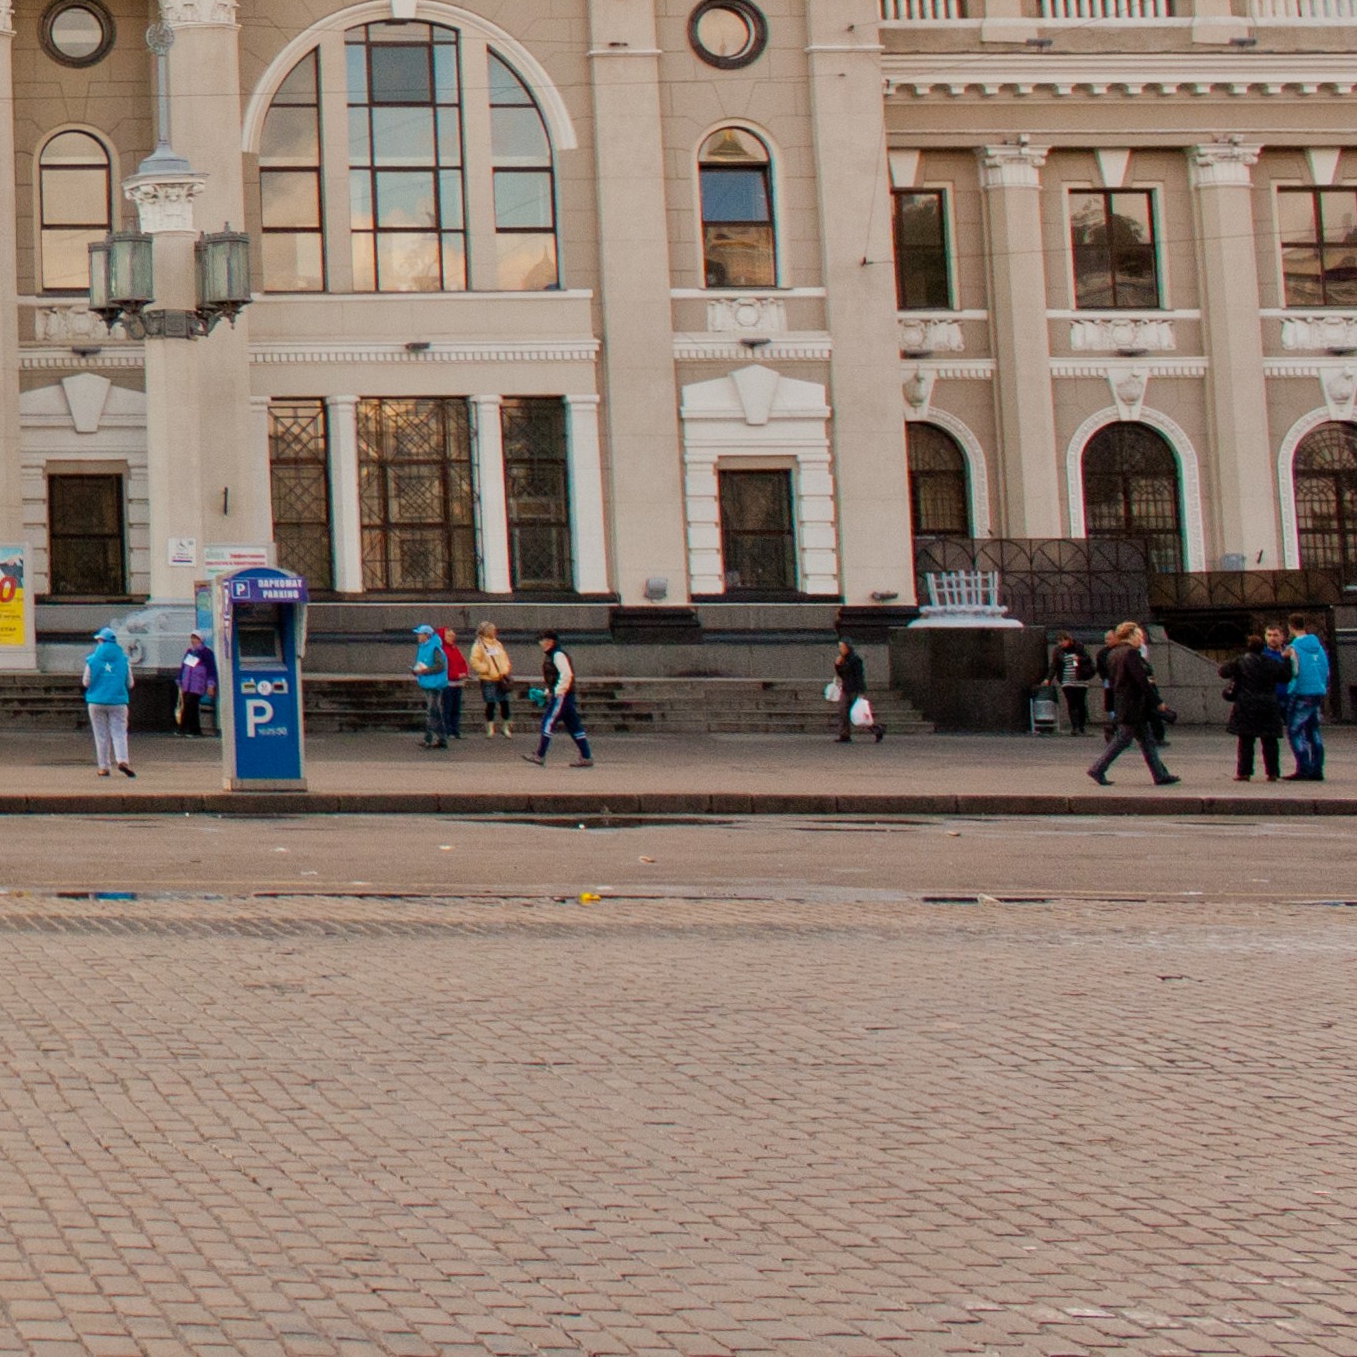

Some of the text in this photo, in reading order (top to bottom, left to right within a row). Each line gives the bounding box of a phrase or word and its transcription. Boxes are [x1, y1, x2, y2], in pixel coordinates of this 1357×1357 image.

[258, 579, 302, 588] ПАРКОМАТ
[235, 583, 246, 595] P
[263, 590, 299, 598] PARKING
[246, 699, 274, 738] P
